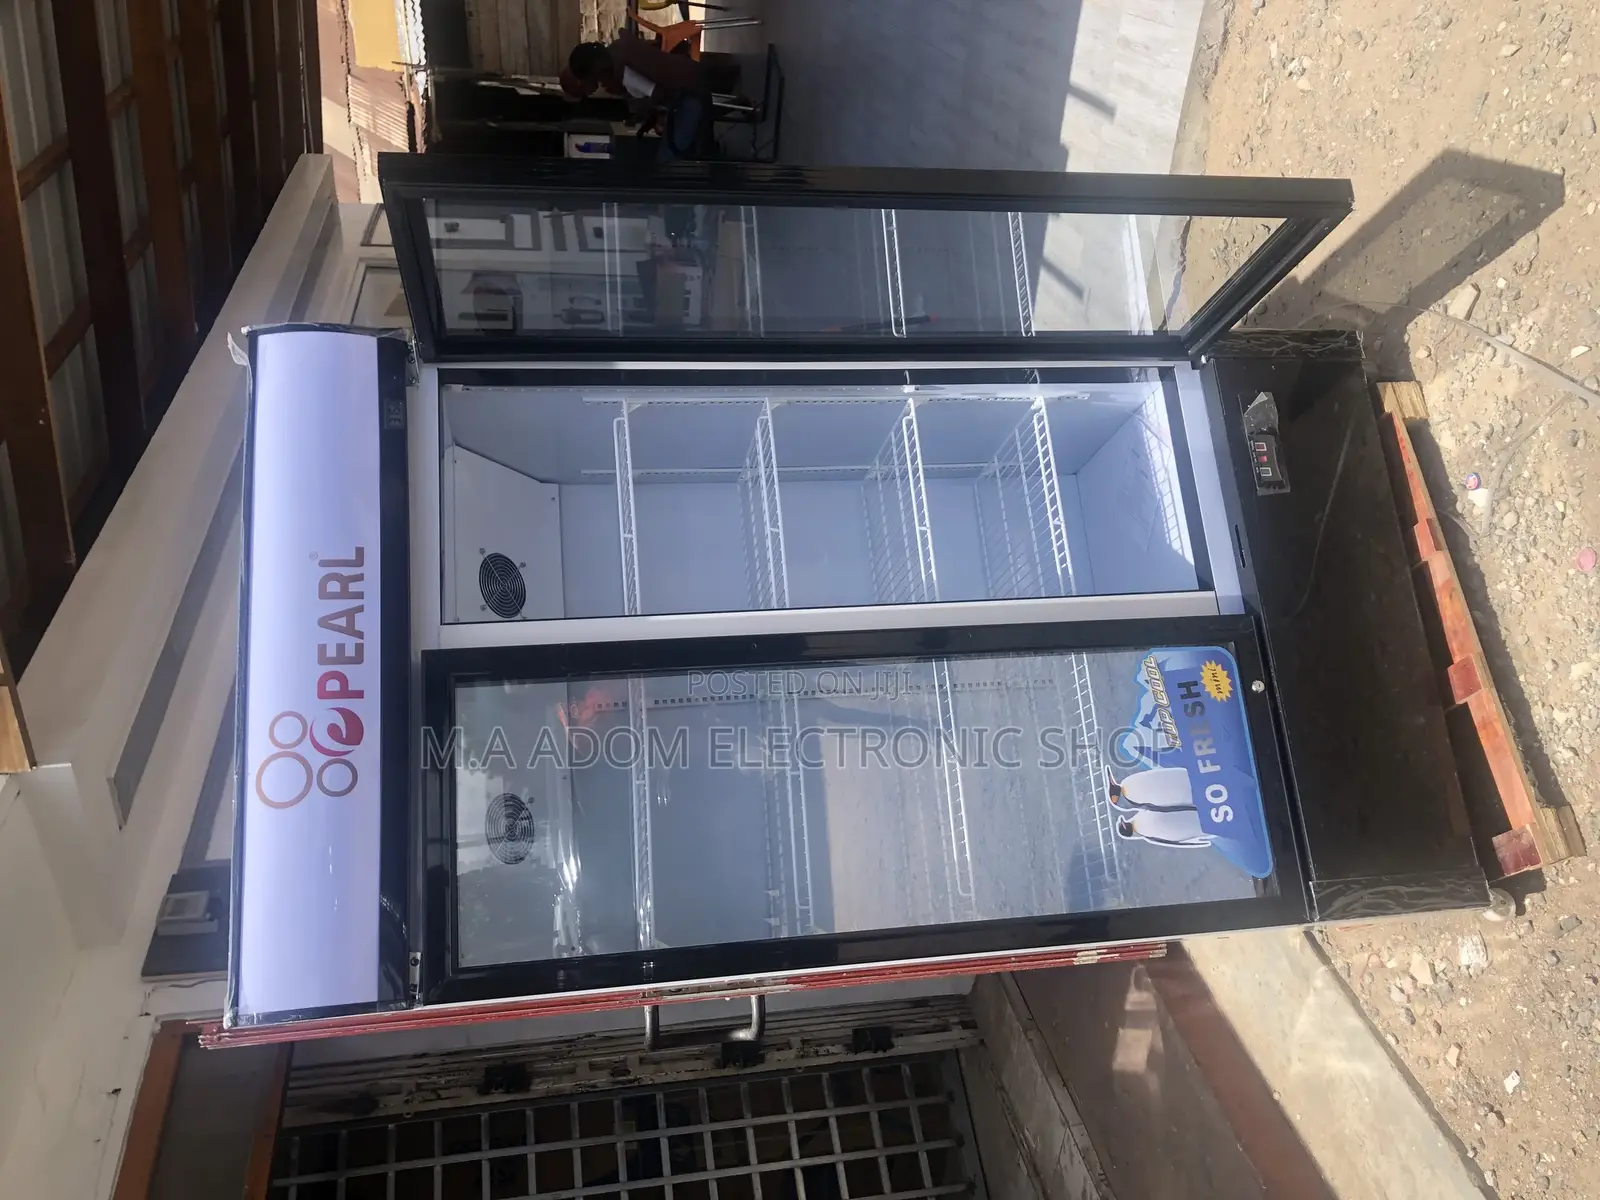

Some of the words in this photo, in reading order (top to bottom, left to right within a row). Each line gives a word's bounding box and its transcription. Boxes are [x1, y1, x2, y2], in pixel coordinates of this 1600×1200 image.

[317, 546, 365, 699] PEARL
[1143, 655, 1170, 707] COOL
[1208, 667, 1224, 694] mini
[1156, 707, 1182, 748] TOP
[1177, 680, 1221, 774] FRESH
[1205, 783, 1234, 823] SO
